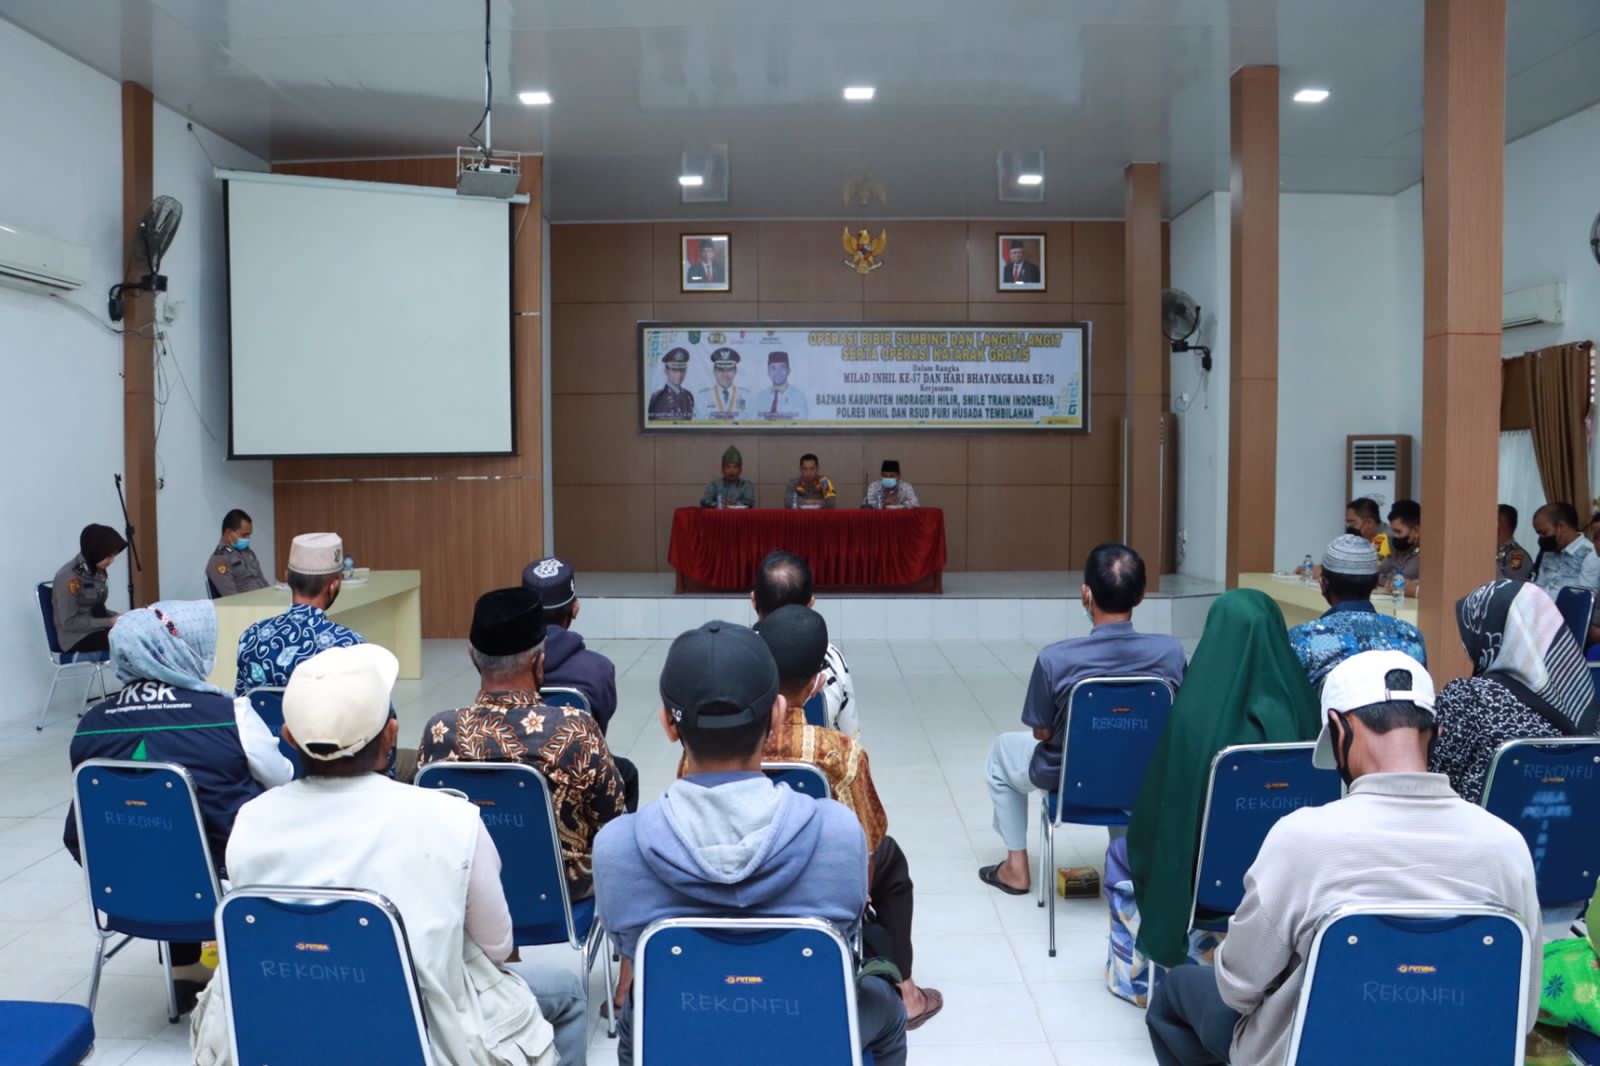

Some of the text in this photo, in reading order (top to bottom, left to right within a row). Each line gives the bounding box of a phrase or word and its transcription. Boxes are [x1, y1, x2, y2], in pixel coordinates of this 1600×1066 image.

[950, 331, 974, 346] DAN
[935, 364, 960, 373] Rangka
[843, 372, 870, 383] MILAD
[872, 372, 897, 383] INHIL
[923, 373, 941, 384] DAN
[943, 373, 964, 384] HARI
[967, 373, 1030, 384] BHAYANGKARA
[849, 394, 893, 405] KABUPATEN
[896, 394, 935, 405] INDRAGIRI
[963, 395, 985, 406] SMILE
[988, 395, 1011, 406] TRAIN
[1013, 395, 1055, 406] INDONESIA
[836, 407, 1034, 419] POLRES INHIL DAN RSUD PURI HUSADA TEMBILAHAN
[261, 960, 367, 983] REKONFU
[1362, 980, 1465, 1007] REKONFU
[680, 991, 800, 1016] REKONFU
